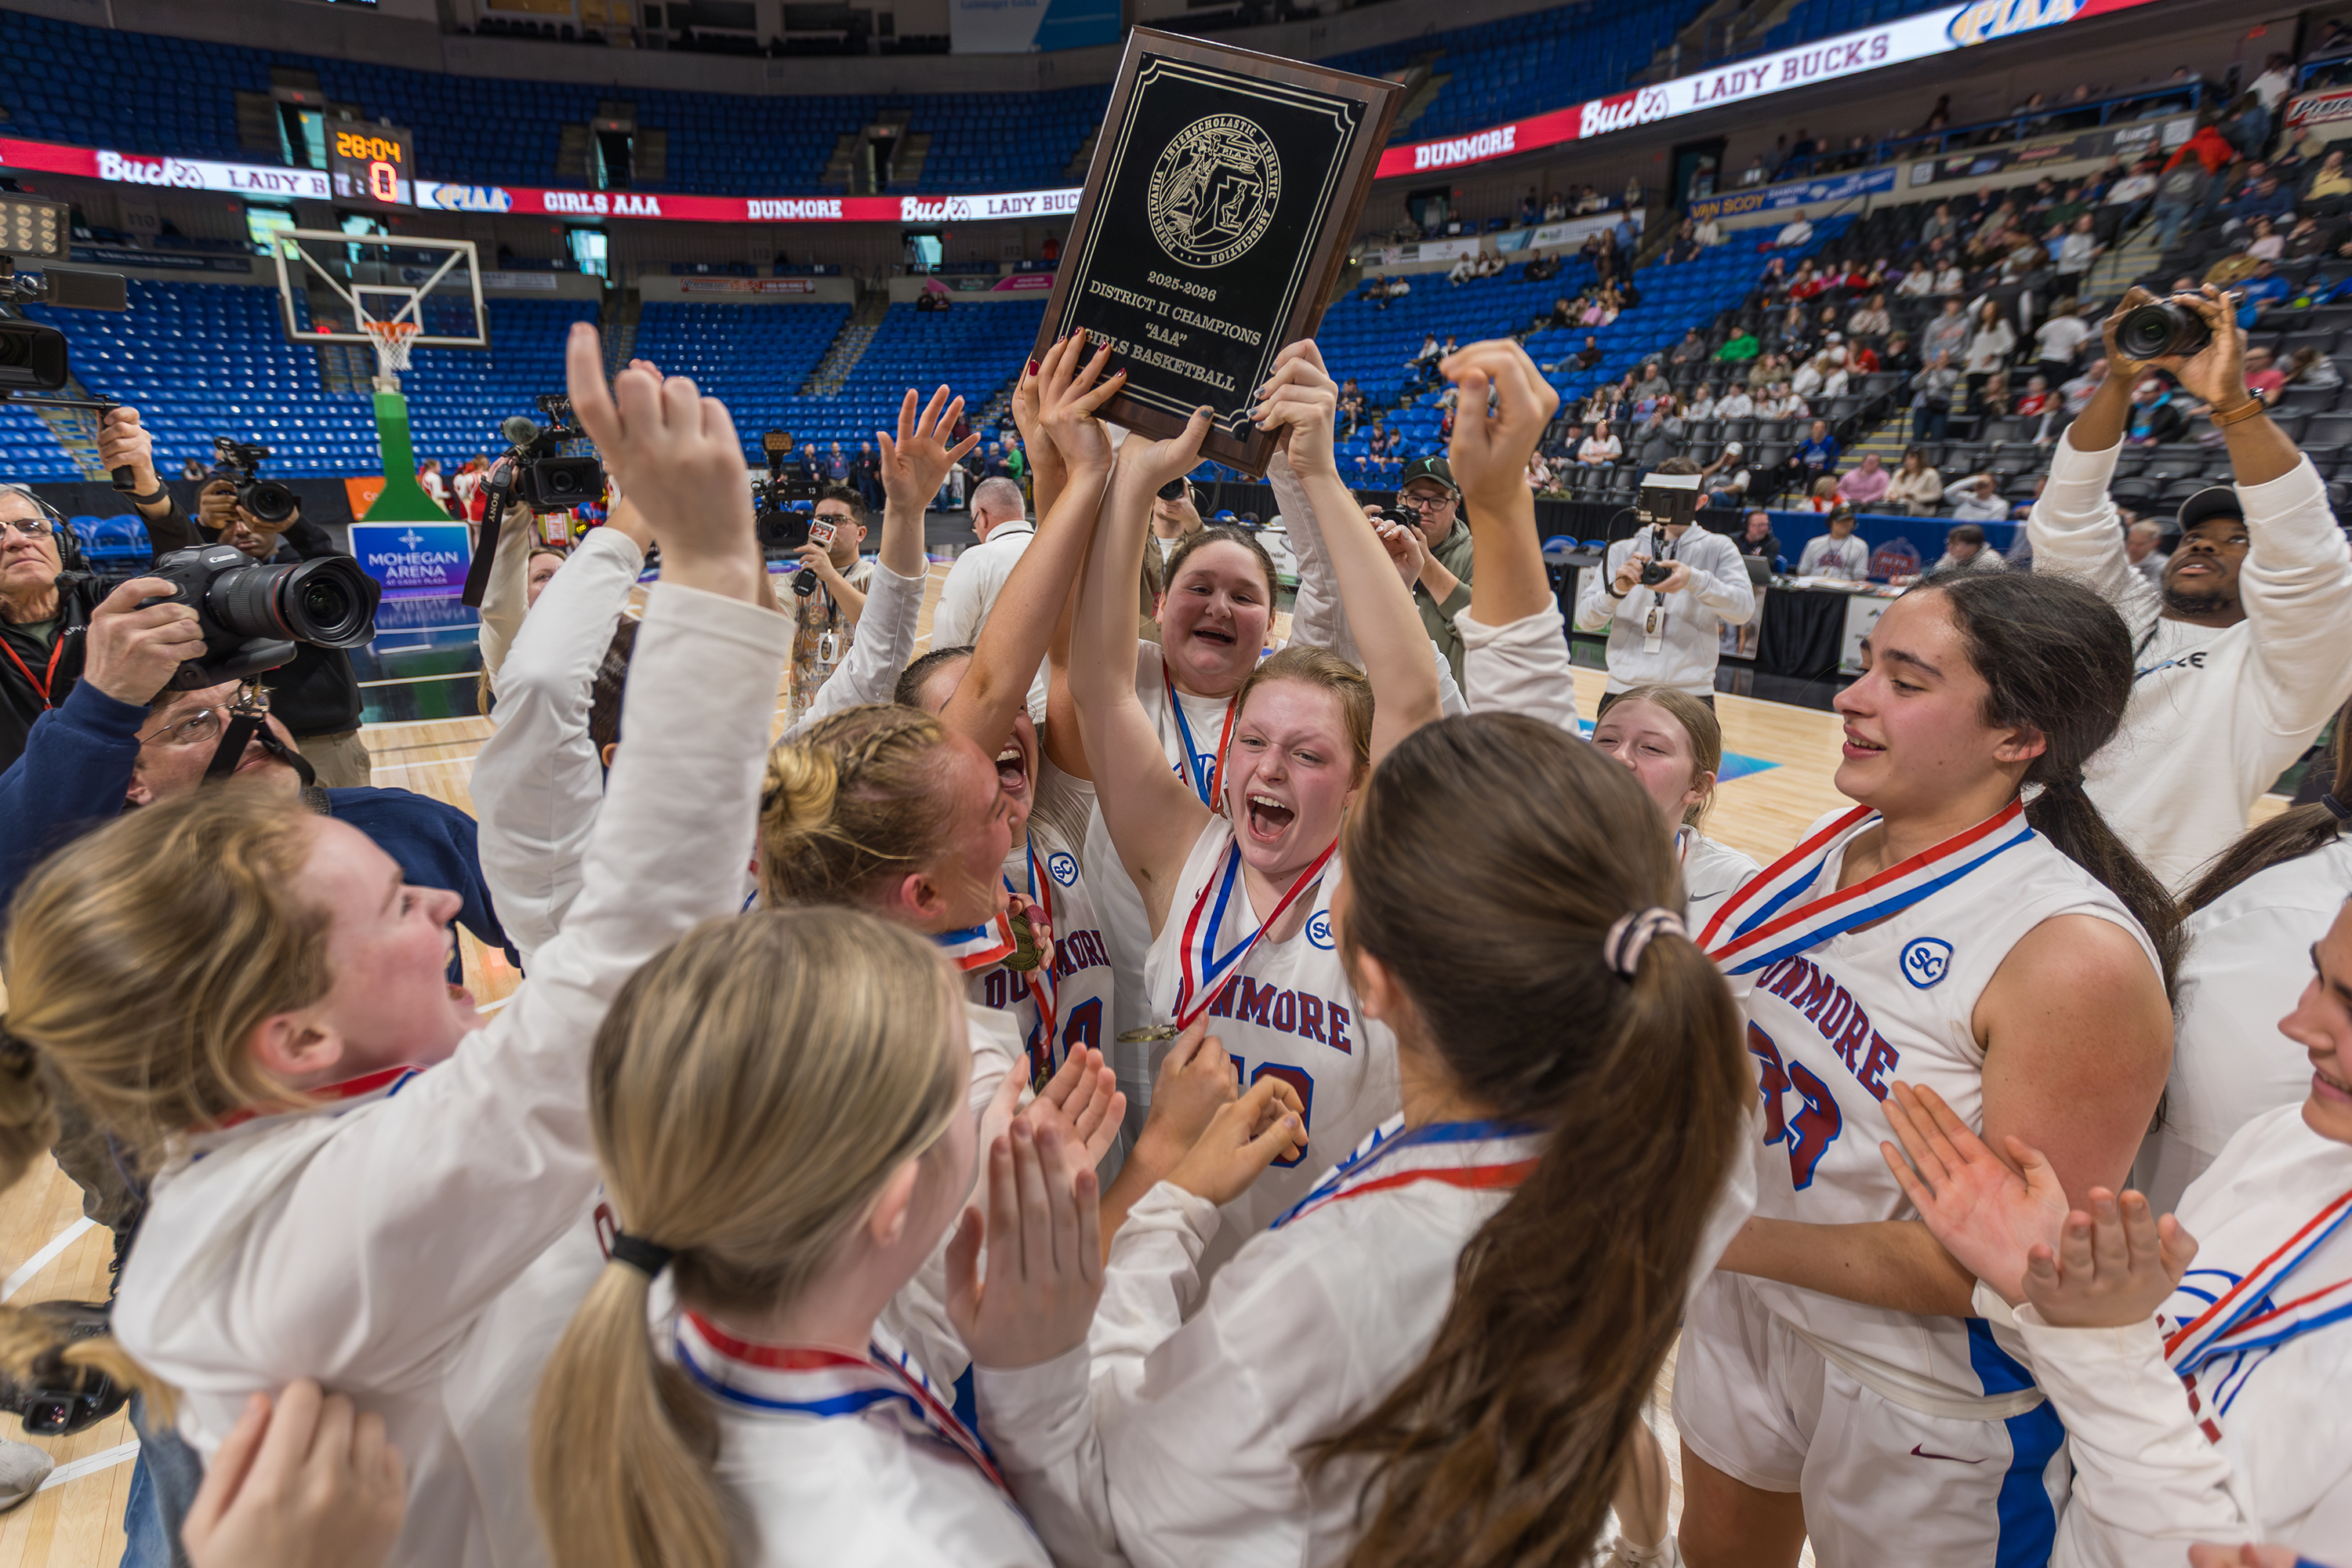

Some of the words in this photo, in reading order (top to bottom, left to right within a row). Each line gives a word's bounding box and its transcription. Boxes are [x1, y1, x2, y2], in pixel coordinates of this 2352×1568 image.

[1579, 85, 1668, 140] Bucks
[1693, 63, 1773, 105] LADY
[1780, 33, 1889, 85] BUCKS
[336, 131, 401, 163] 28:04
[1163, 118, 1258, 162] INTERSCHOLASTIC
[1414, 125, 1516, 170] DUNMORE
[96, 148, 204, 190] Bucks
[227, 169, 301, 193] LADY
[1259, 140, 1278, 199] ATHLETIC
[446, 184, 510, 213] PIAA
[543, 191, 608, 214] GIRLS
[612, 194, 662, 216] AAA
[747, 199, 843, 220] DUNMORE
[901, 196, 971, 222] Bucks
[987, 197, 1038, 215] LADY
[1043, 194, 1080, 211] BUC
[1150, 171, 1176, 252] PENNSYLVANIA
[1210, 209, 1271, 264] ASSOCIATION
[1147, 270, 1217, 302] 2025-2026
[1089, 280, 1156, 312] DISTRICT
[1156, 301, 1171, 317] II
[1172, 307, 1262, 346] CHAMPIONS
[1131, 344, 1236, 392] BASKETBALL
[488, 492, 500, 523] SONY
[813, 527, 829, 539] 22
[368, 550, 459, 567] MOHEGAN
[385, 564, 447, 579] ARENA
[1909, 946, 1944, 978] SC
[1171, 974, 1352, 1056] NMORE
[1755, 955, 1900, 1104] UNMORE
